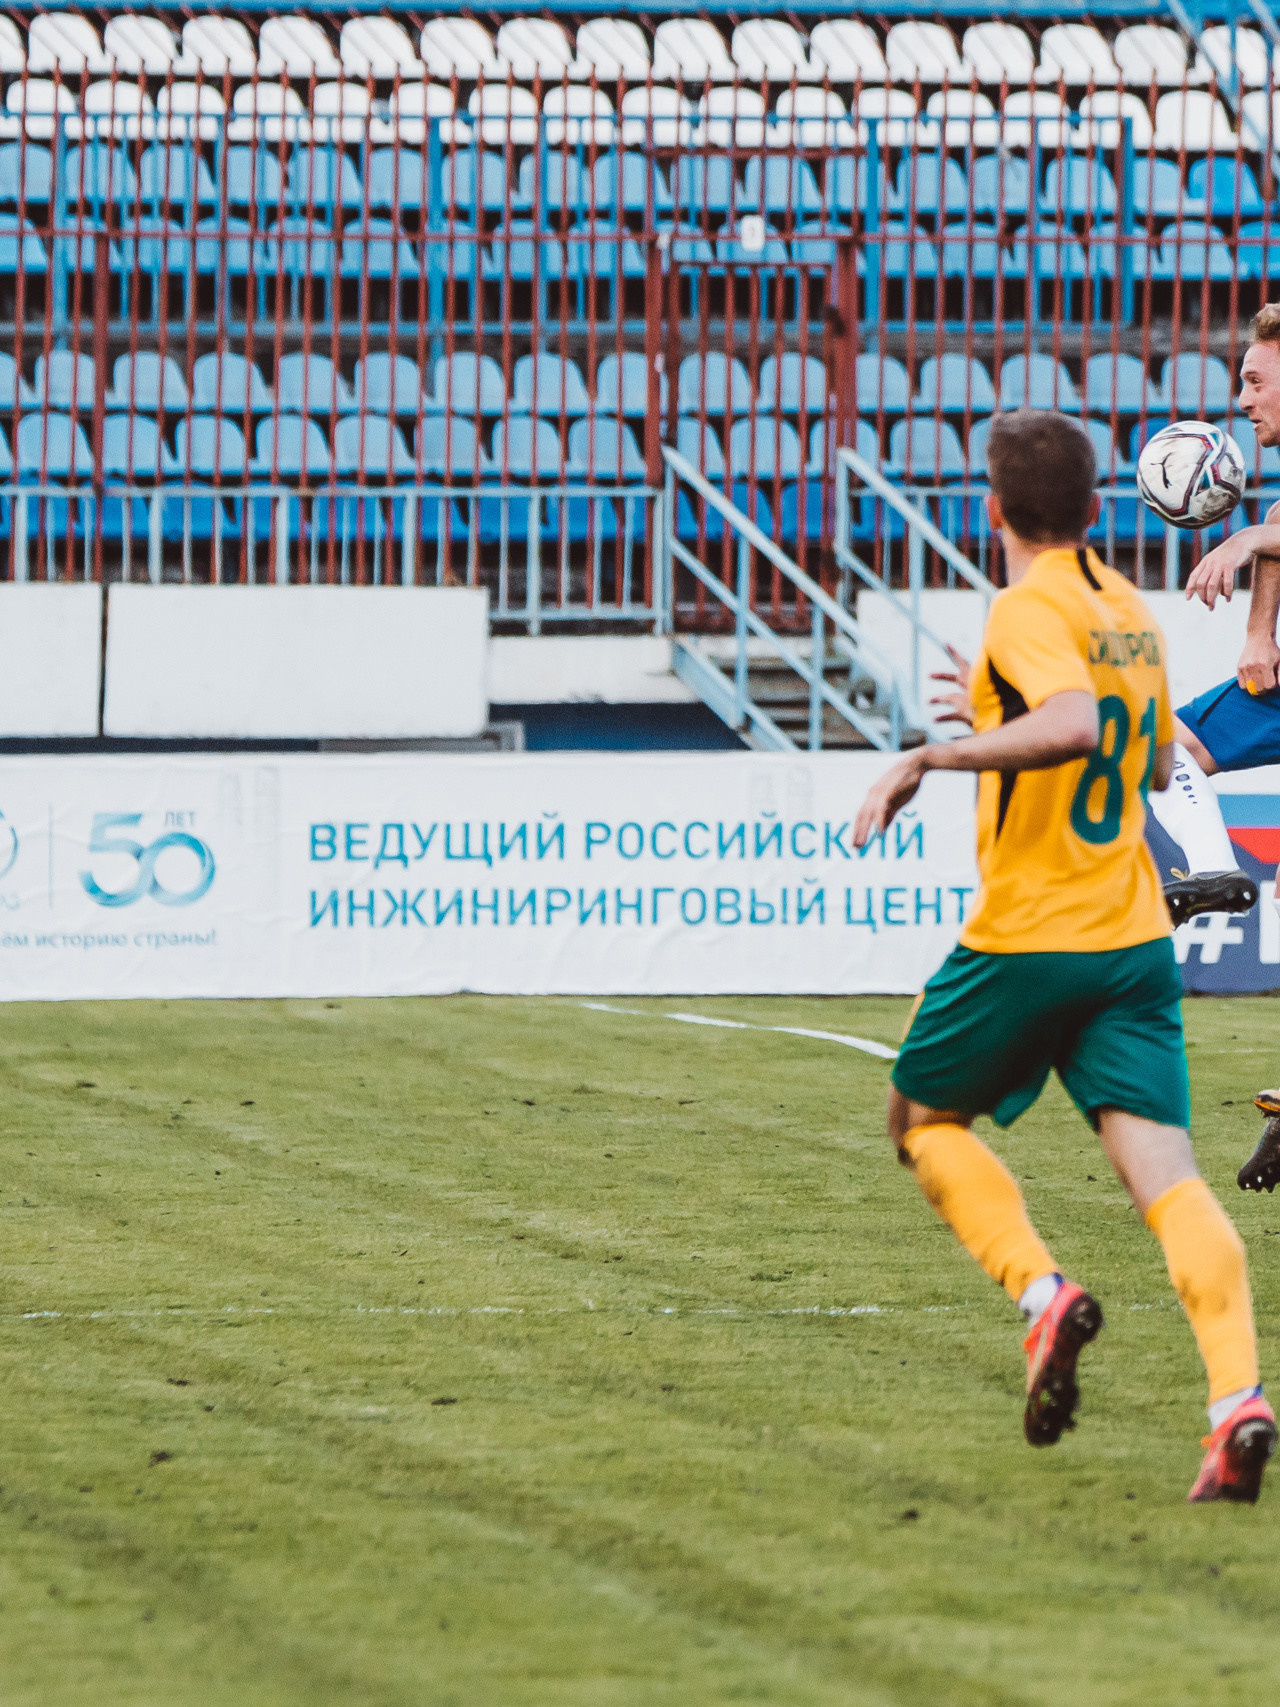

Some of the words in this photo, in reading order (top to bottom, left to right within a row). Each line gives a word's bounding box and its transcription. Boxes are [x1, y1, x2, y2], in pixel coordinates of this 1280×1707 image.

[1070, 694, 1156, 845] 81
[164, 810, 197, 828] ЛЕТ
[309, 811, 566, 870] ВЕДУЩИЙ
[584, 810, 925, 860] РОССИЙСКИЙ
[78, 812, 216, 908] 50
[309, 877, 827, 928] ИНЖИНИРИНГОВЫЙ
[845, 886, 975, 934] ЦЕНТ
[35, 931, 127, 950] историю
[133, 928, 218, 950] страны!
